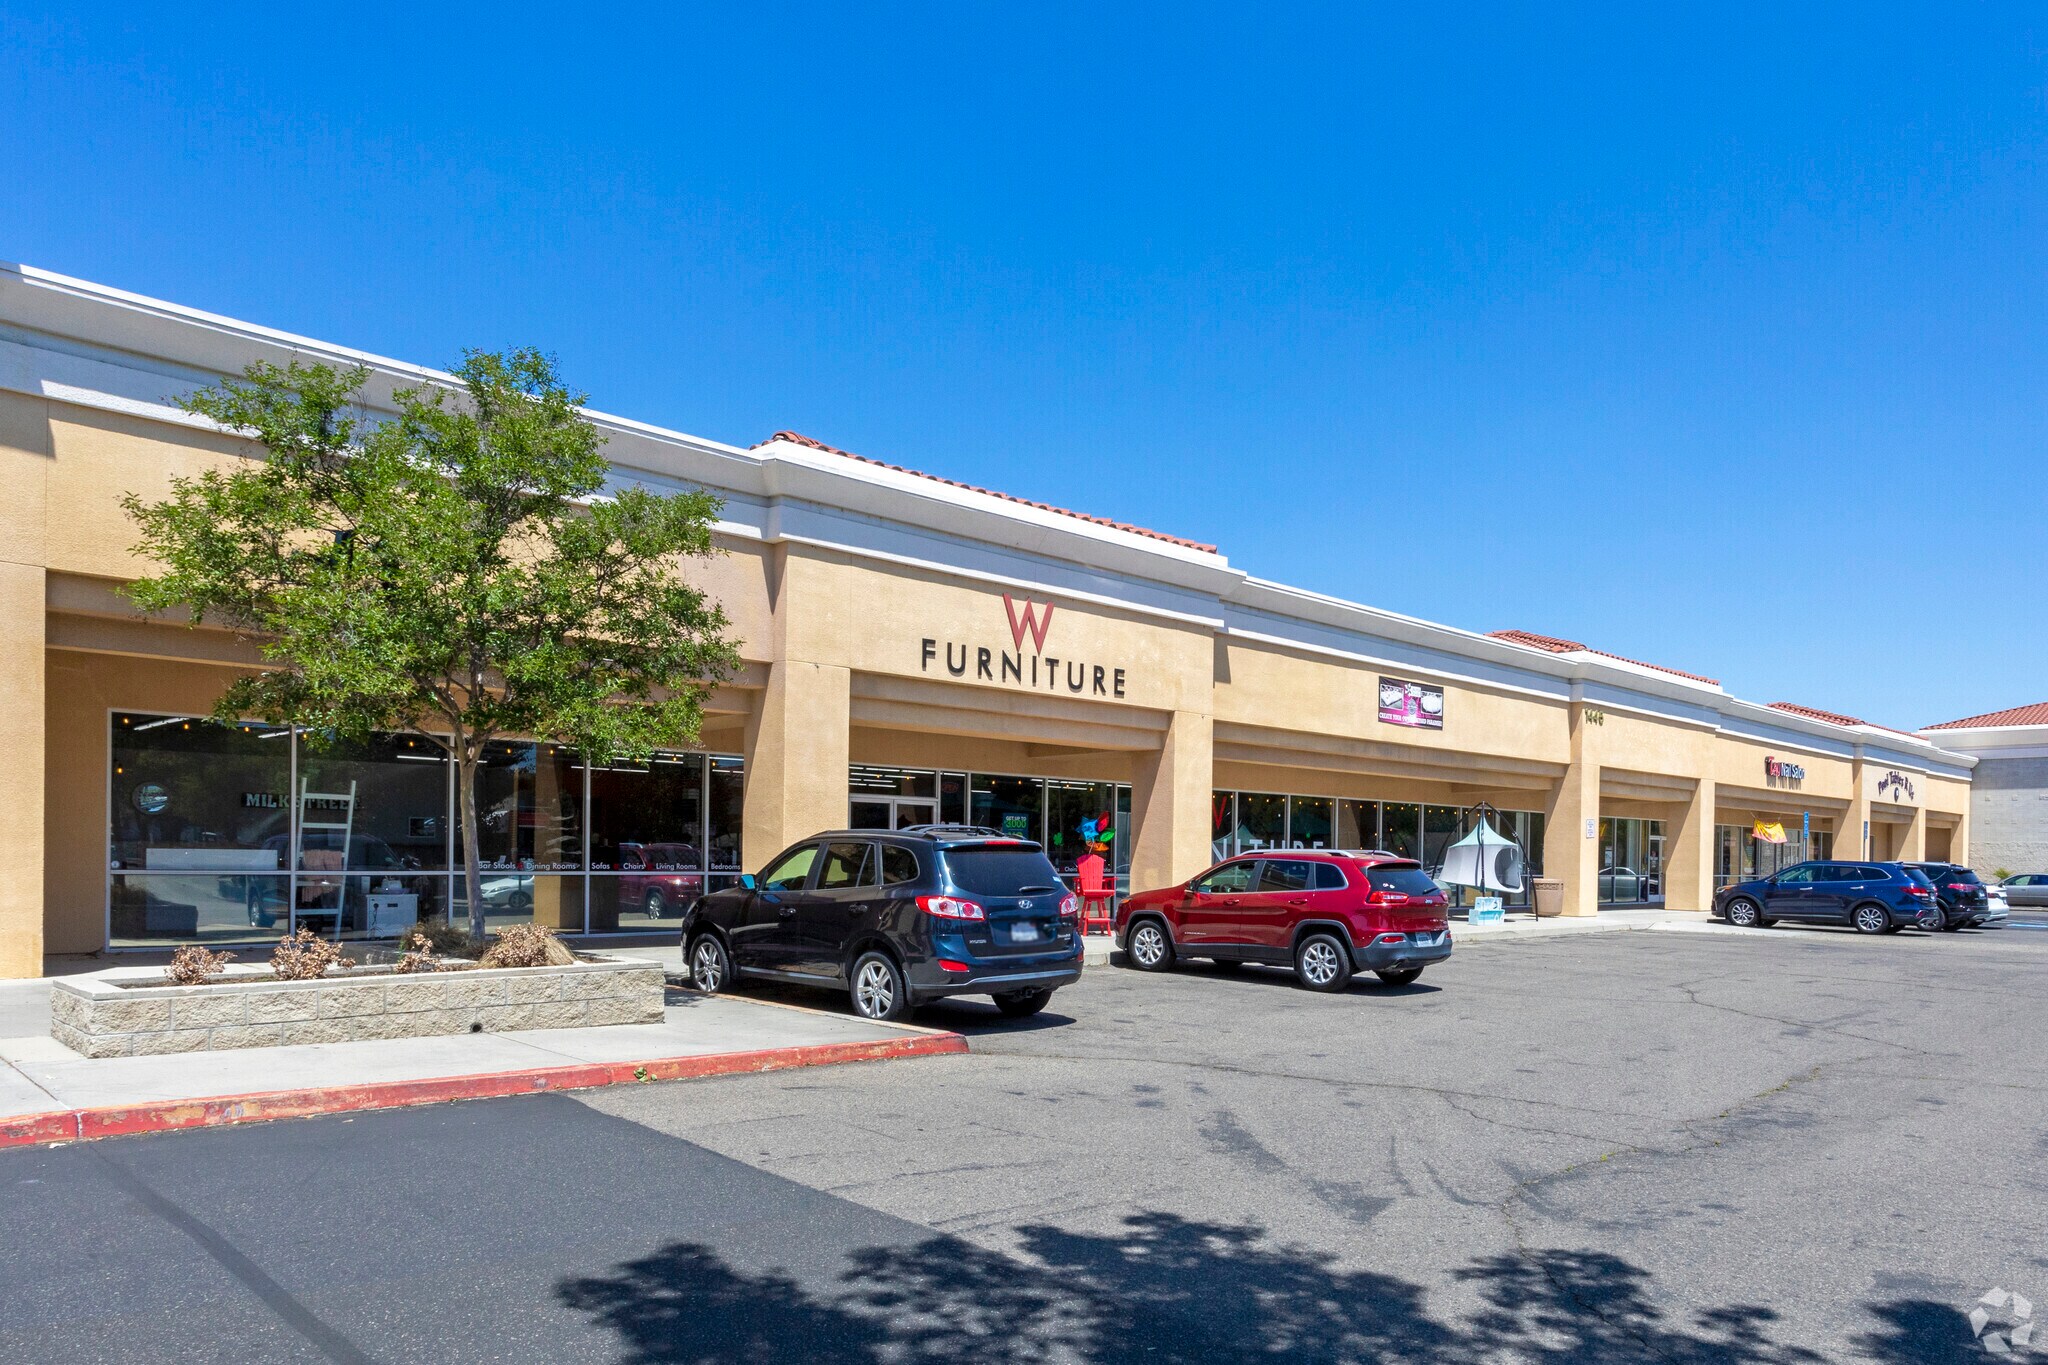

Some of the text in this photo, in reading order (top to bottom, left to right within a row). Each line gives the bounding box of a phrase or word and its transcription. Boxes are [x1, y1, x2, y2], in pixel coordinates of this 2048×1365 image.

[1002, 592, 1055, 656] W
[921, 638, 1126, 698] FURNITURE
[1780, 762, 1791, 777] Nail
[1791, 763, 1805, 779] Salon
[245, 793, 289, 808] MILK
[494, 861, 516, 869] Stools
[527, 862, 551, 871] Dining
[656, 862, 675, 871] Living
